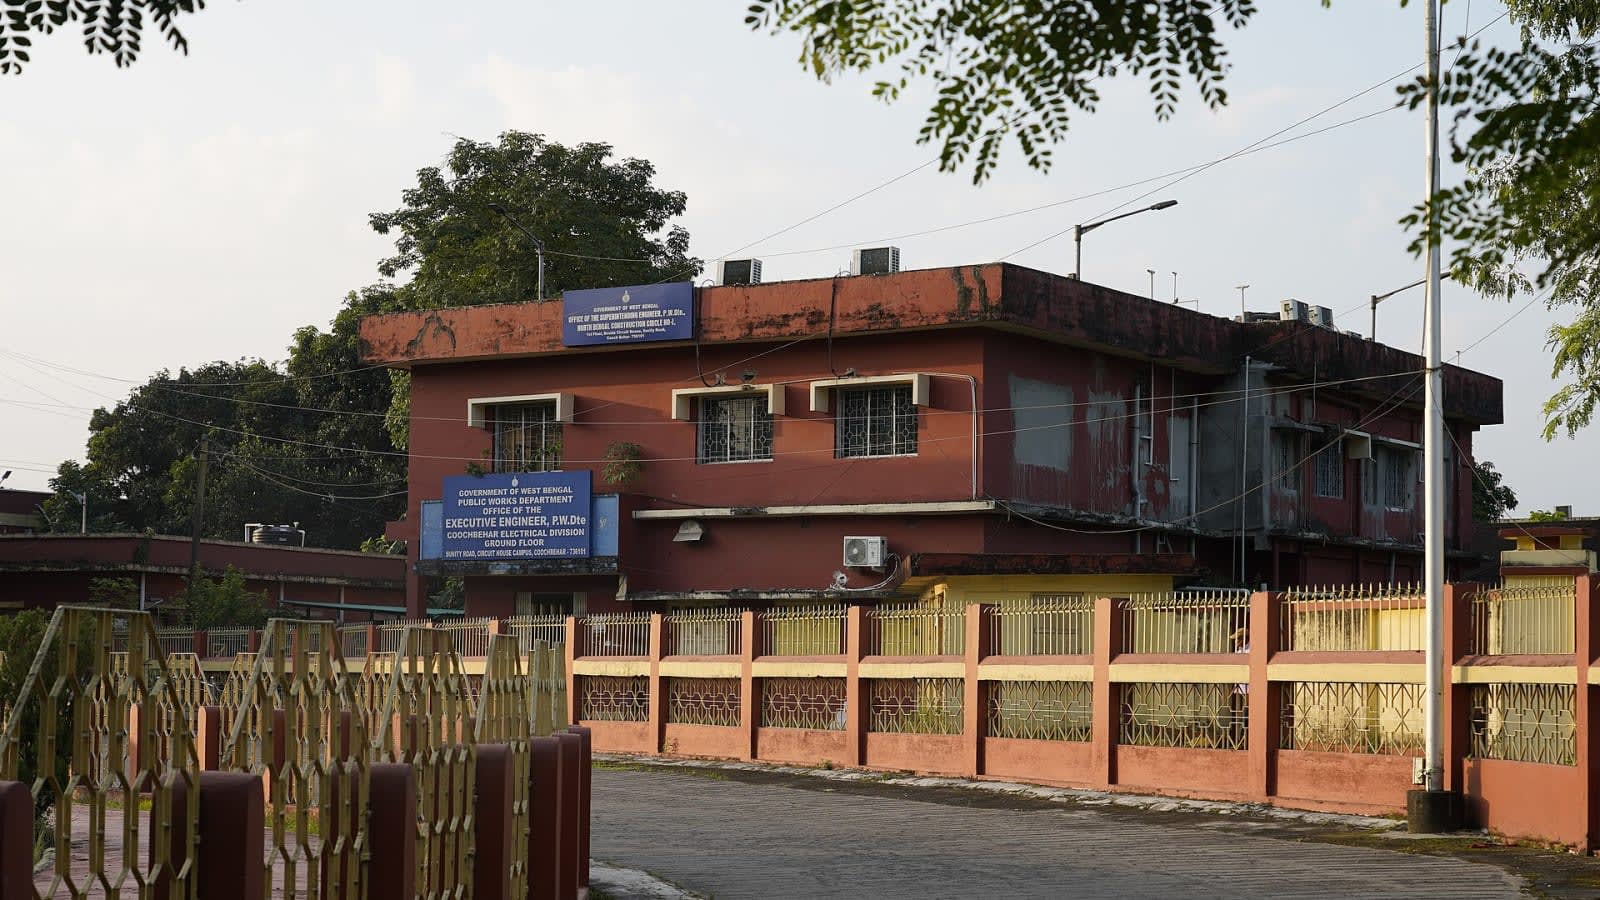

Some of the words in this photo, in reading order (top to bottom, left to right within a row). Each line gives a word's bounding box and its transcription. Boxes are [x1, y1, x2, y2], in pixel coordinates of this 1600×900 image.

[569, 315, 583, 323] OFFICE
[600, 312, 638, 321] SUPERINTENDING
[611, 320, 646, 329] CONSTRUCTION
[459, 488, 508, 496] GOVERNMENT
[519, 496, 573, 504] DEPARTMENT
[446, 518, 496, 528] EXECUTIVE
[499, 516, 550, 527] ENGINEER,
[552, 516, 586, 525] P.W.Dte
